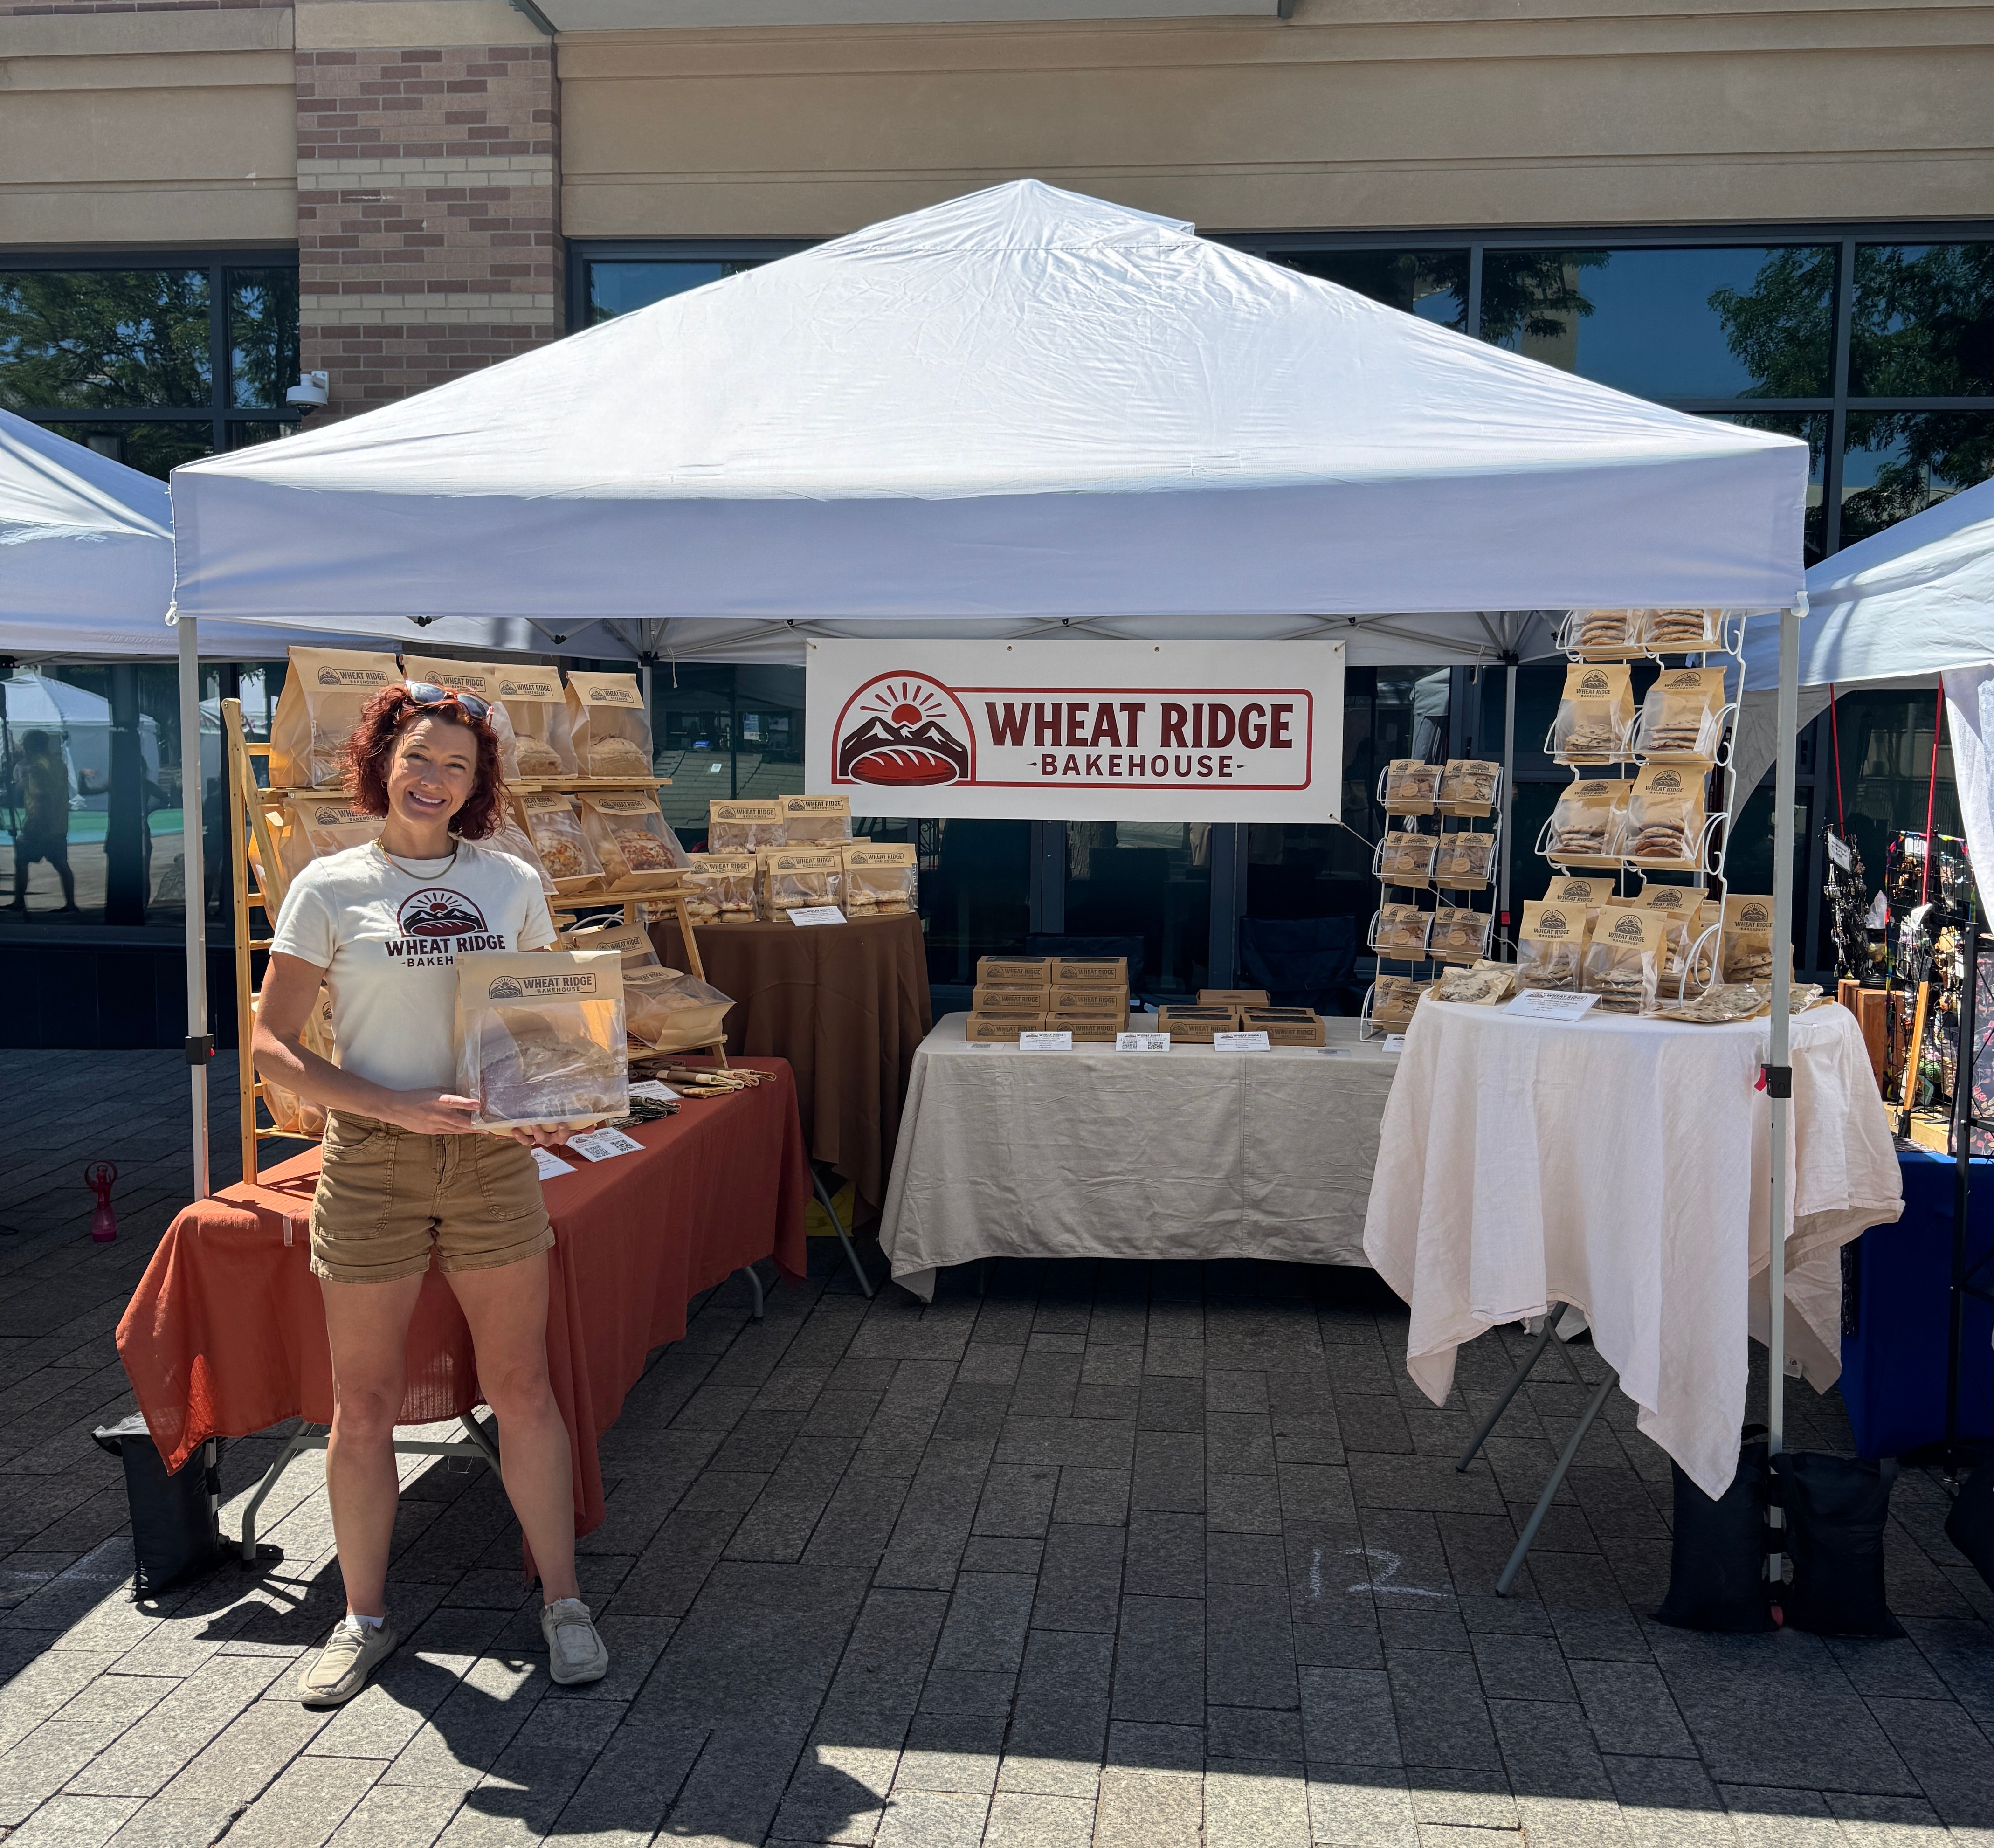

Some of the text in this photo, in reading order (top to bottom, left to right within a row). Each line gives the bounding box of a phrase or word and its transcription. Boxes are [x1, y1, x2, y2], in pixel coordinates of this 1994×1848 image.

[339, 671, 386, 681] WHEAT RIDGE
[444, 676, 483, 687] WHEAT RIDGE
[985, 702, 1293, 749] WHEAT RIDGE
[385, 935, 506, 957] WHEAT RIDGE
[407, 956, 453, 967] BAKEH
[524, 976, 592, 989] WHEAT RIDGE
